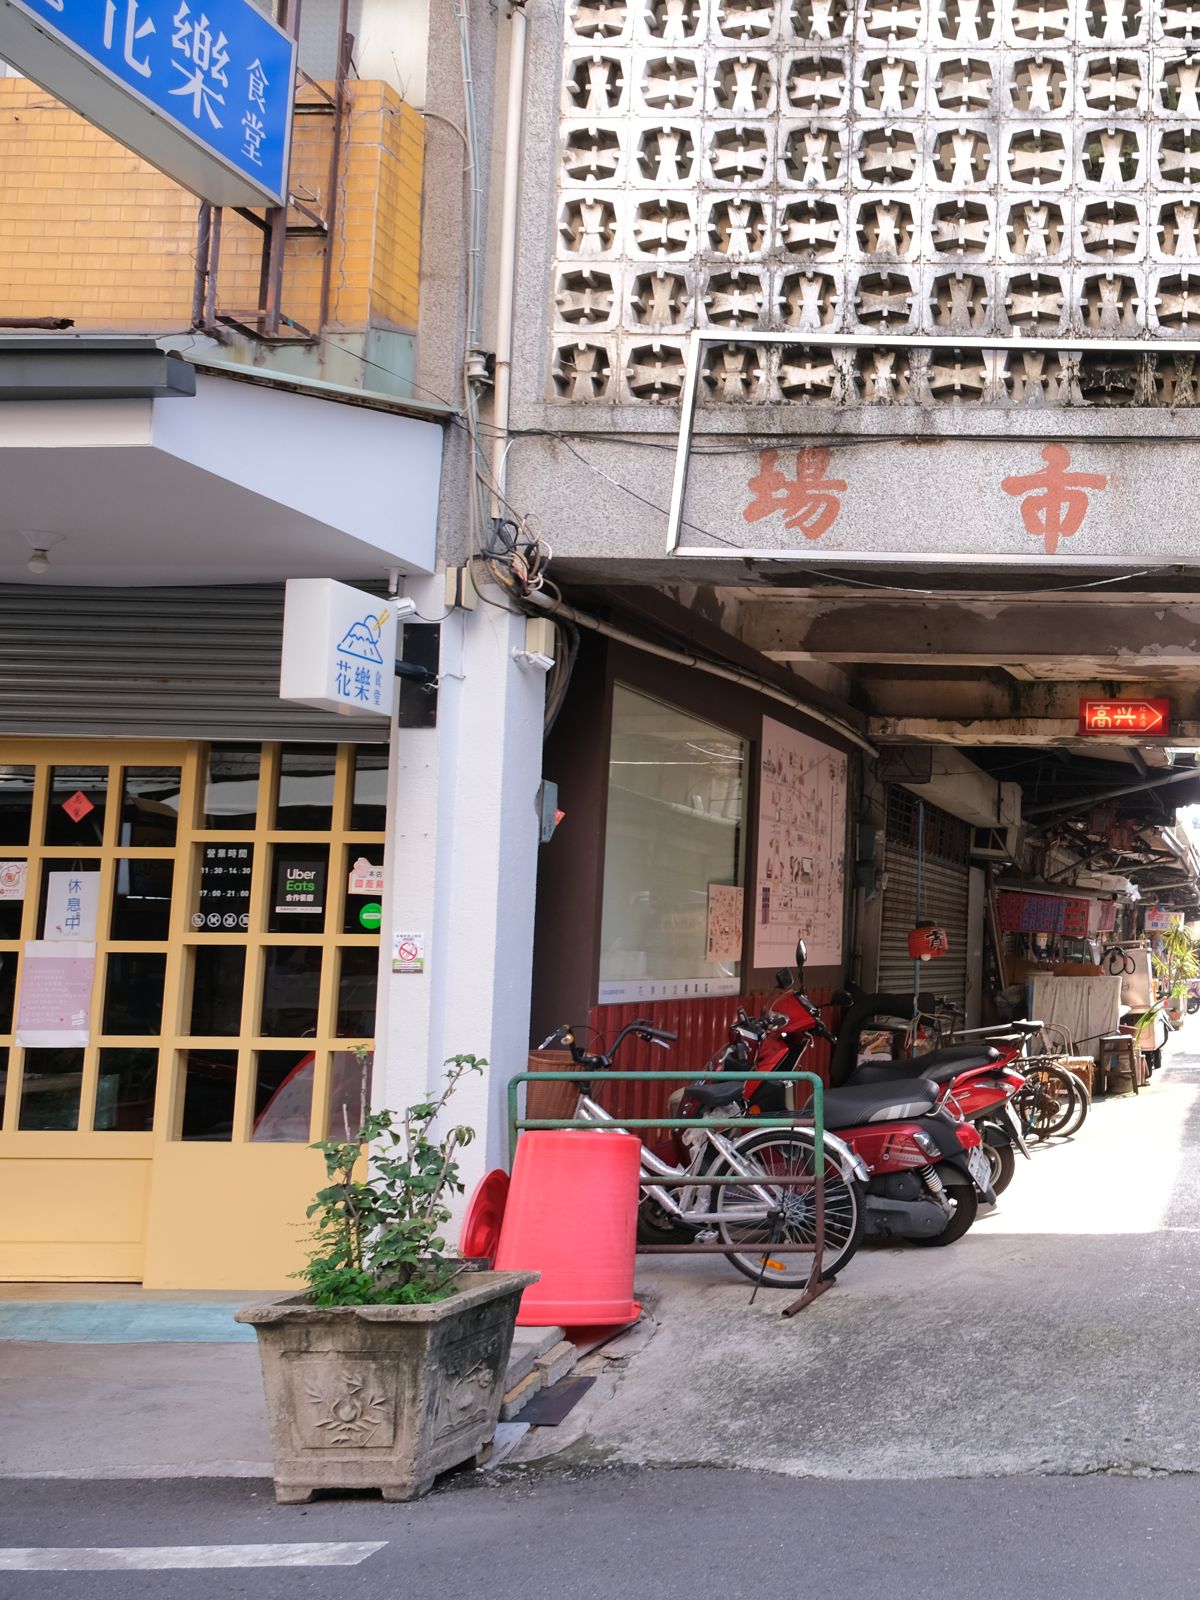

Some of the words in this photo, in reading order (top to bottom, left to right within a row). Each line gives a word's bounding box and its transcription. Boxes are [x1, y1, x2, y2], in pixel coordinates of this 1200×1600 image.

[241, 58, 269, 167] 食堂
[335, 660, 371, 701] 花樂
[206, 848, 248, 858] 營業時間
[286, 868, 316, 880] Uber
[286, 880, 316, 891] Eats
[64, 879, 83, 930] 休息中
